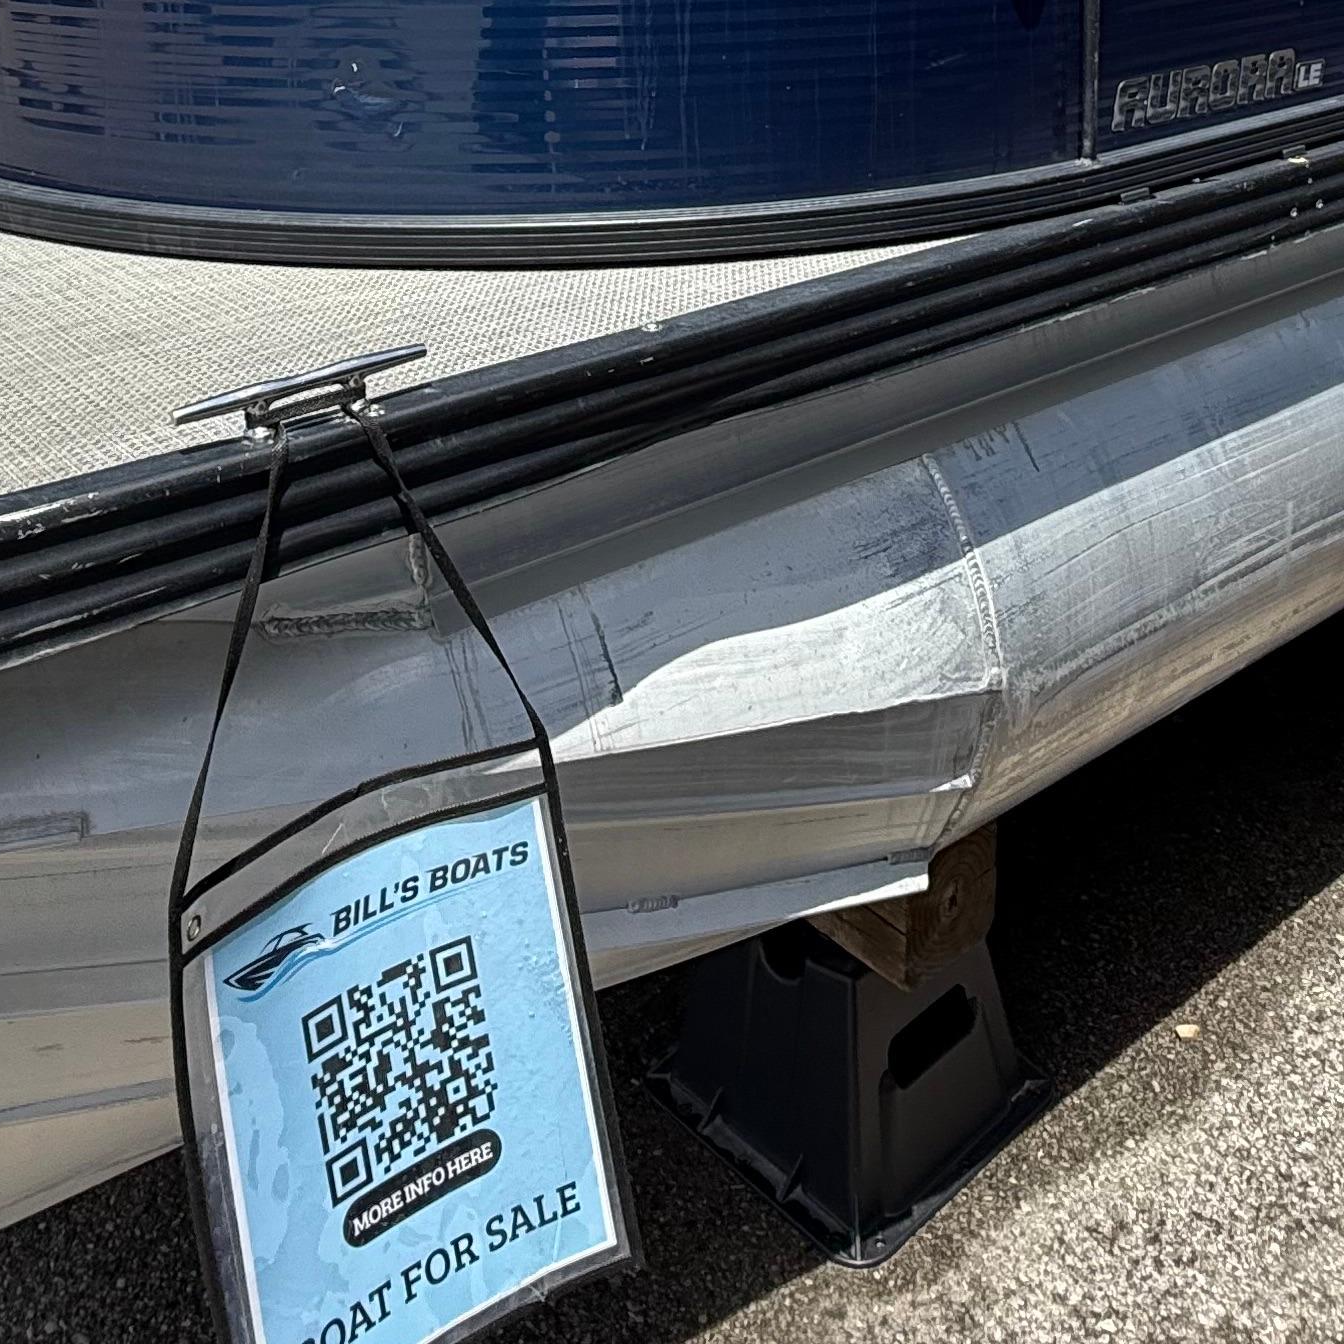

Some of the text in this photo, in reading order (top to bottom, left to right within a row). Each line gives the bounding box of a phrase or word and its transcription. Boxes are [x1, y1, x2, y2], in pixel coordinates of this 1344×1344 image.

[1111, 48, 1324, 133] AURORA LE
[329, 840, 529, 938] BILL'S BOATS
[352, 1141, 494, 1237] MORE INFO HERE
[301, 1180, 582, 1344] OAT FOR SALE
